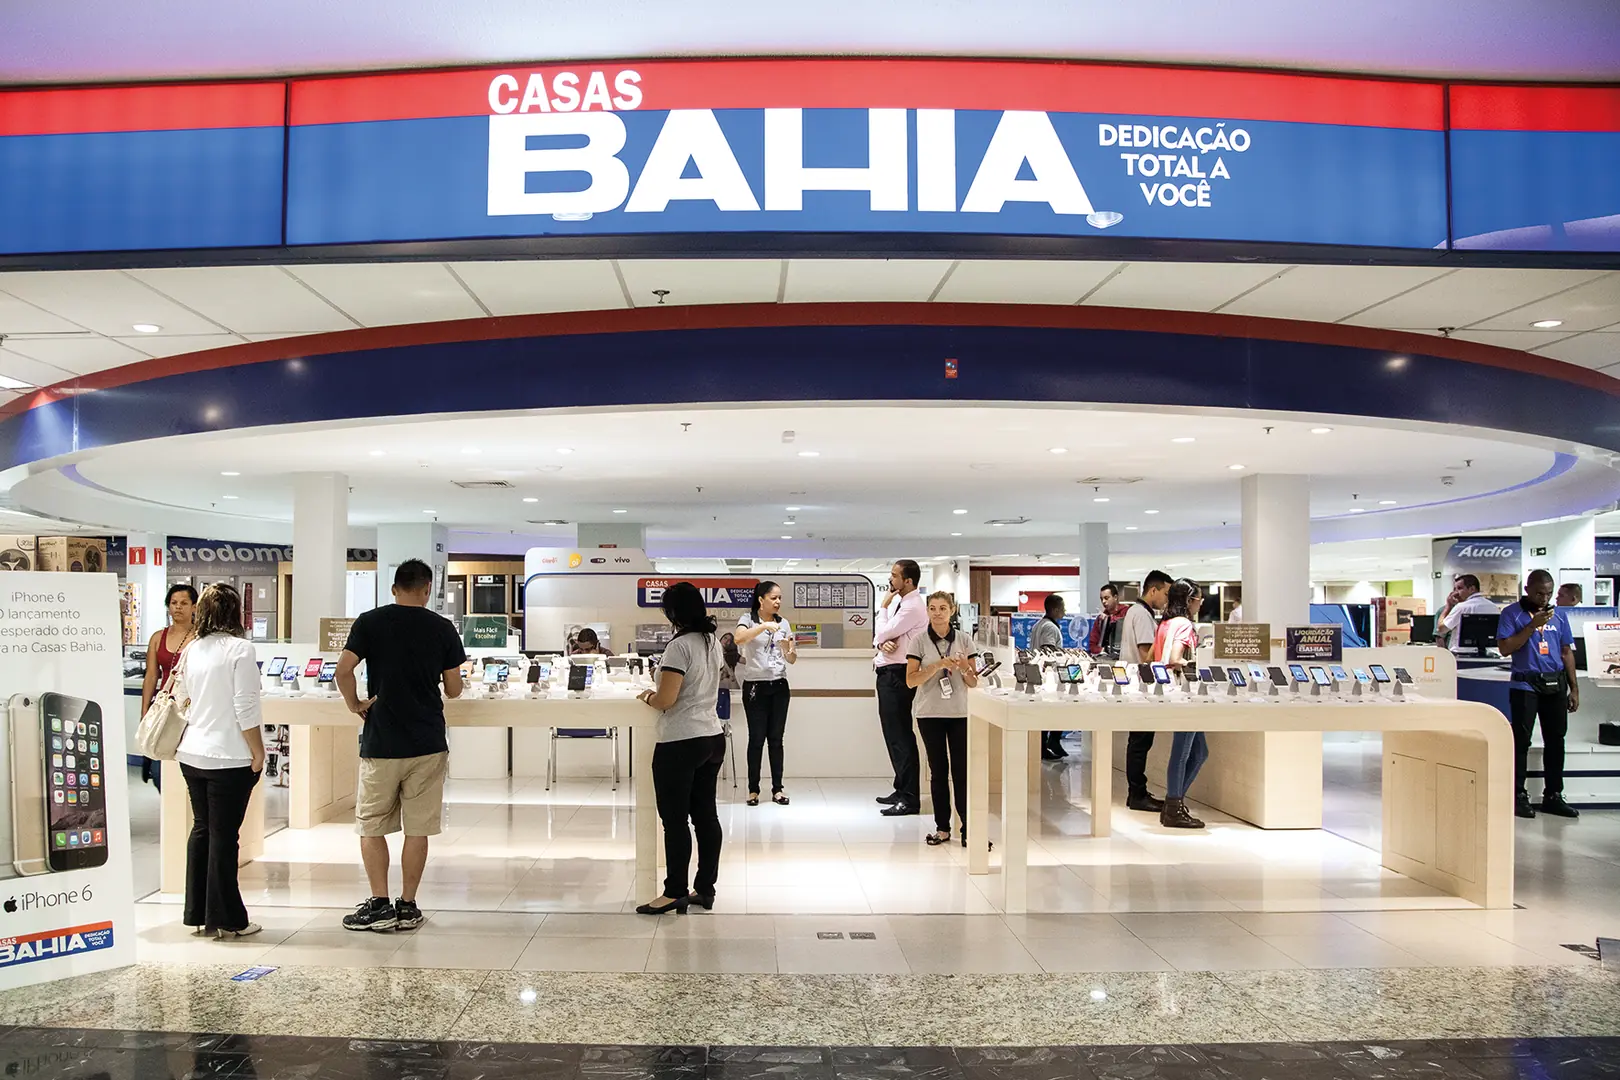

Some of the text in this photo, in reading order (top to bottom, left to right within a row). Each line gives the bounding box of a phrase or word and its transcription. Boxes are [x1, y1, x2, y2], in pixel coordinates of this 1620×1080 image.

[488, 70, 643, 114] CASAS
[1099, 123, 1251, 154] DEDICAÇÃO
[487, 108, 1096, 216] BAHIA
[1121, 153, 1230, 179] TOTAL A
[1140, 179, 1211, 207] VOCÊ
[1458, 545, 1513, 558] Áudio
[645, 580, 668, 588] CASAS
[11, 592, 66, 603] iPhone 6
[645, 588, 732, 603] BIA
[8, 609, 81, 620] lançamento
[0, 625, 106, 637] esperado do ano.
[12, 644, 28, 653] na
[31, 642, 67, 653] Casas
[70, 641, 106, 652] Bahia.
[21, 884, 93, 910] iPhone 6
